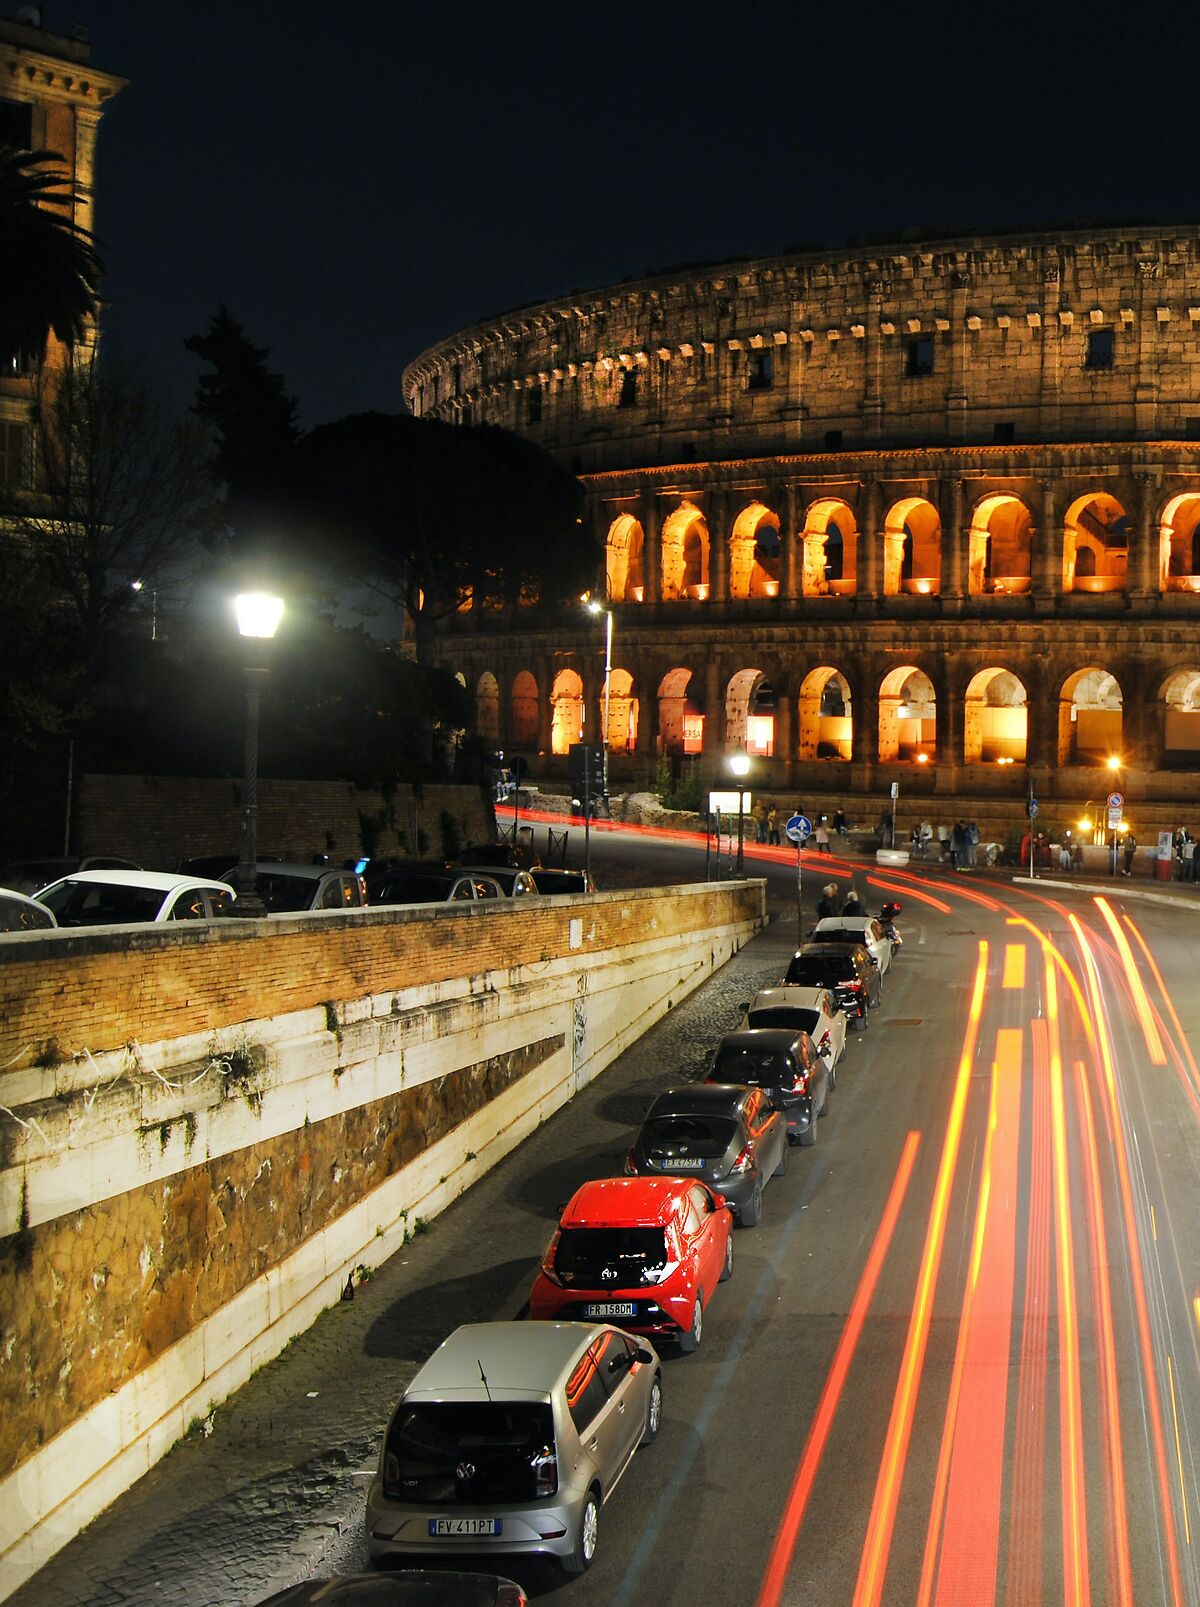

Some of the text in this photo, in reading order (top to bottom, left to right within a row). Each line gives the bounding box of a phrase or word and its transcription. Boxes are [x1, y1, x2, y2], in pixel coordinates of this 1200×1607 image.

[589, 1304, 632, 1315] FR 158DM
[438, 1520, 493, 1533] FV 411PT
